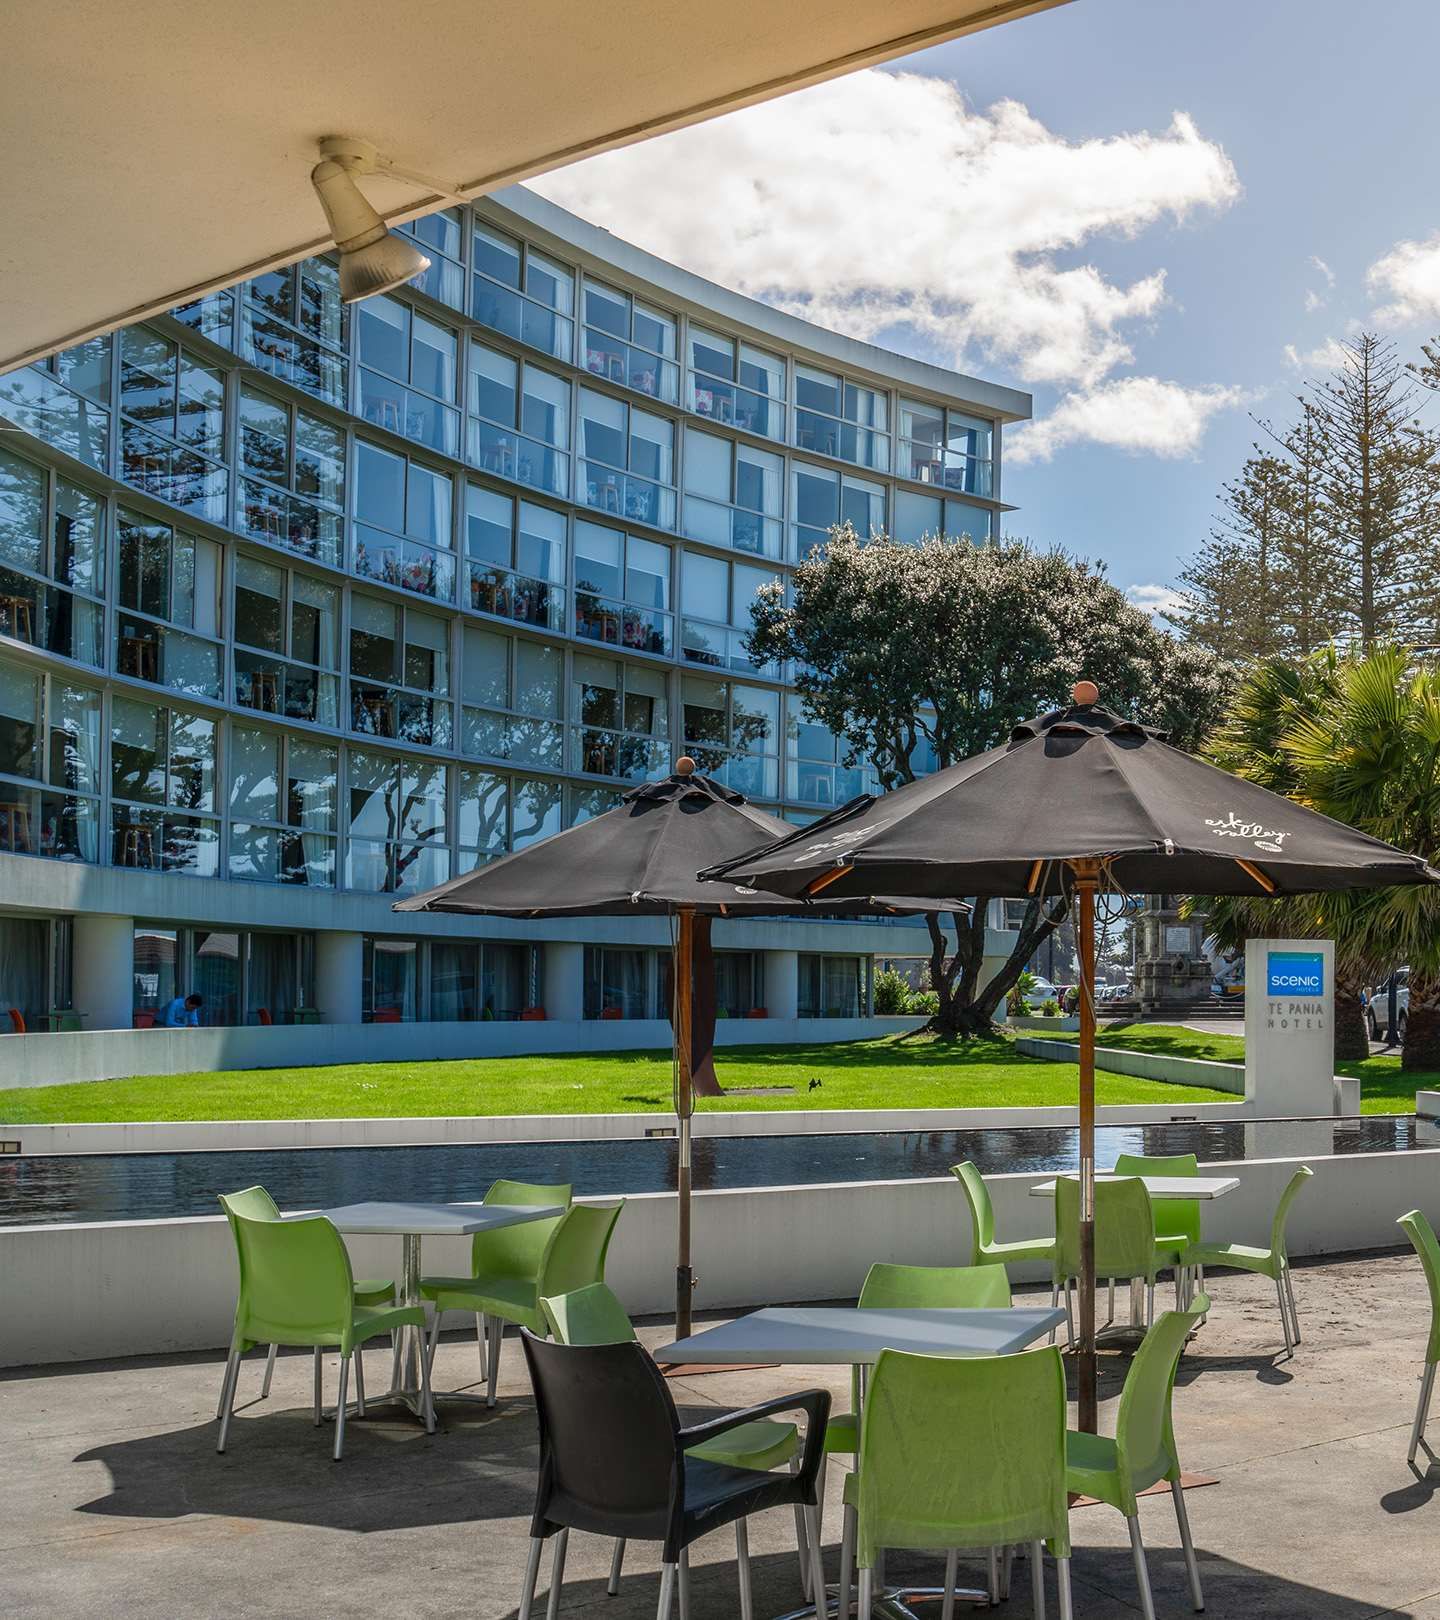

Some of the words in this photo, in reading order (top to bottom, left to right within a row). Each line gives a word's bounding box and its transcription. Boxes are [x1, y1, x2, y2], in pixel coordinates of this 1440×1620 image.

[1205, 812, 1256, 829] esk
[1268, 1002, 1283, 1015] TE
[1289, 1002, 1324, 1015] PANIA
[1268, 1018, 1324, 1029] HOTEL
